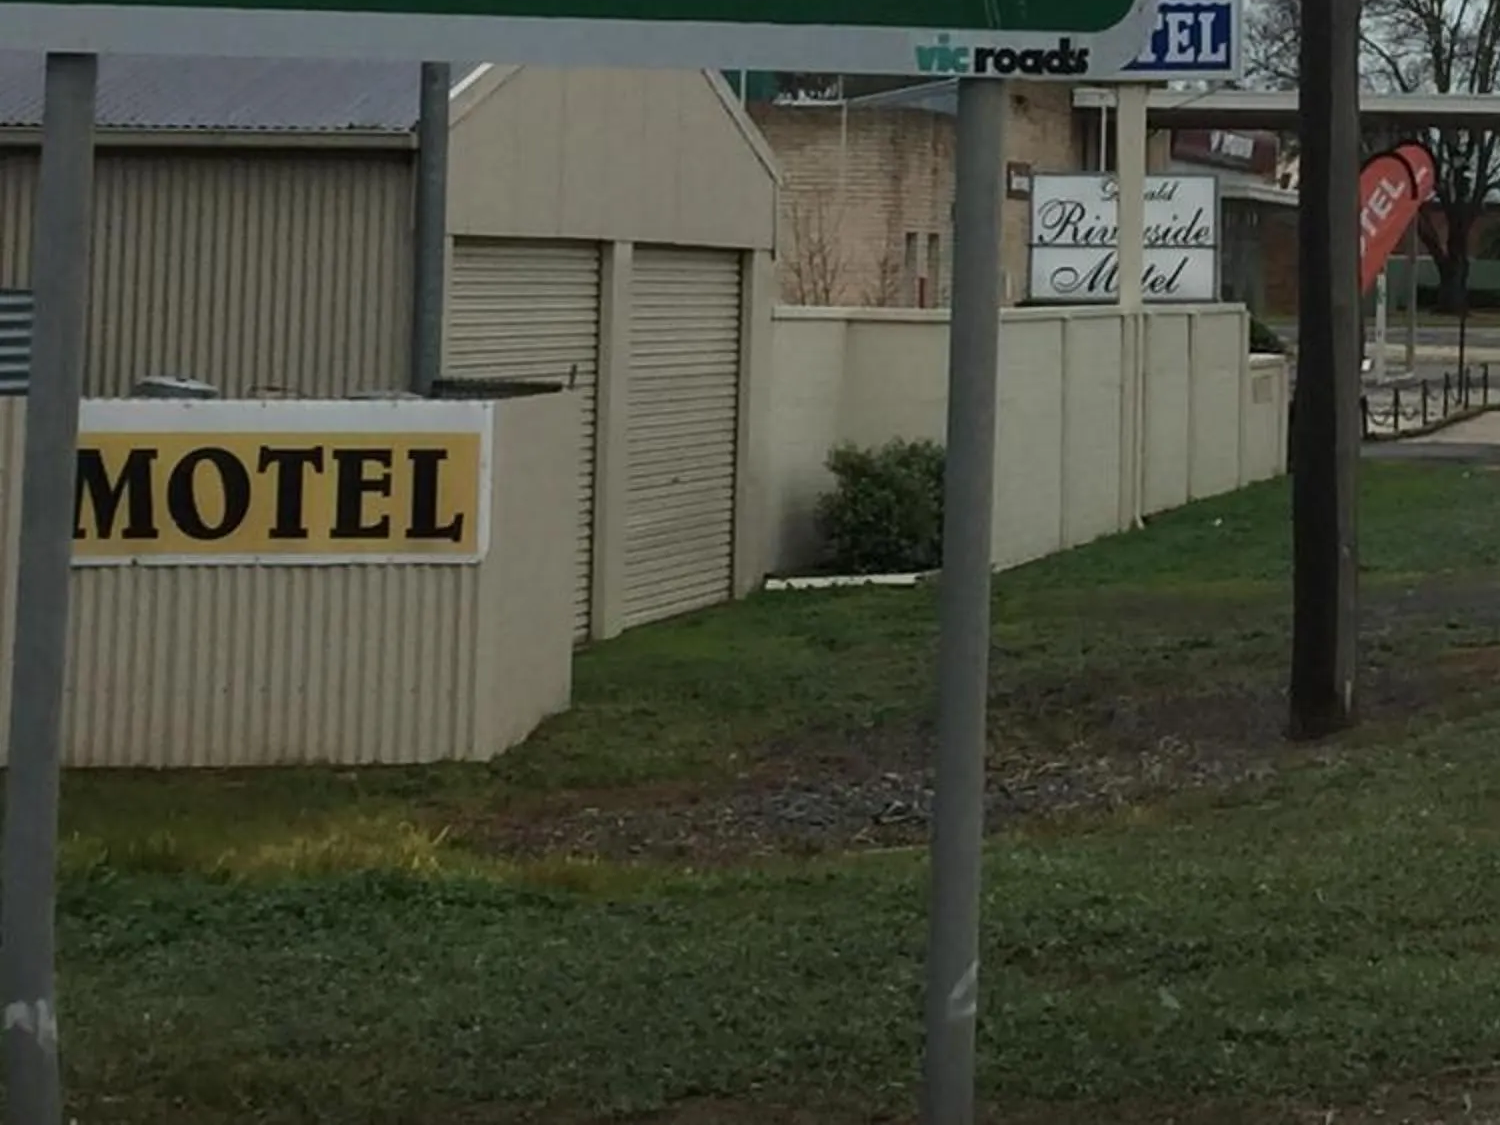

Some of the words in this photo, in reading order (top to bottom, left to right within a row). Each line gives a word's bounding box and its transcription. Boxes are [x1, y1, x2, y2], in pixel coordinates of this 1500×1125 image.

[1038, 198, 1210, 244] Rivside
[1051, 251, 1189, 295] Mtel
[71, 445, 465, 543] MOTEL
